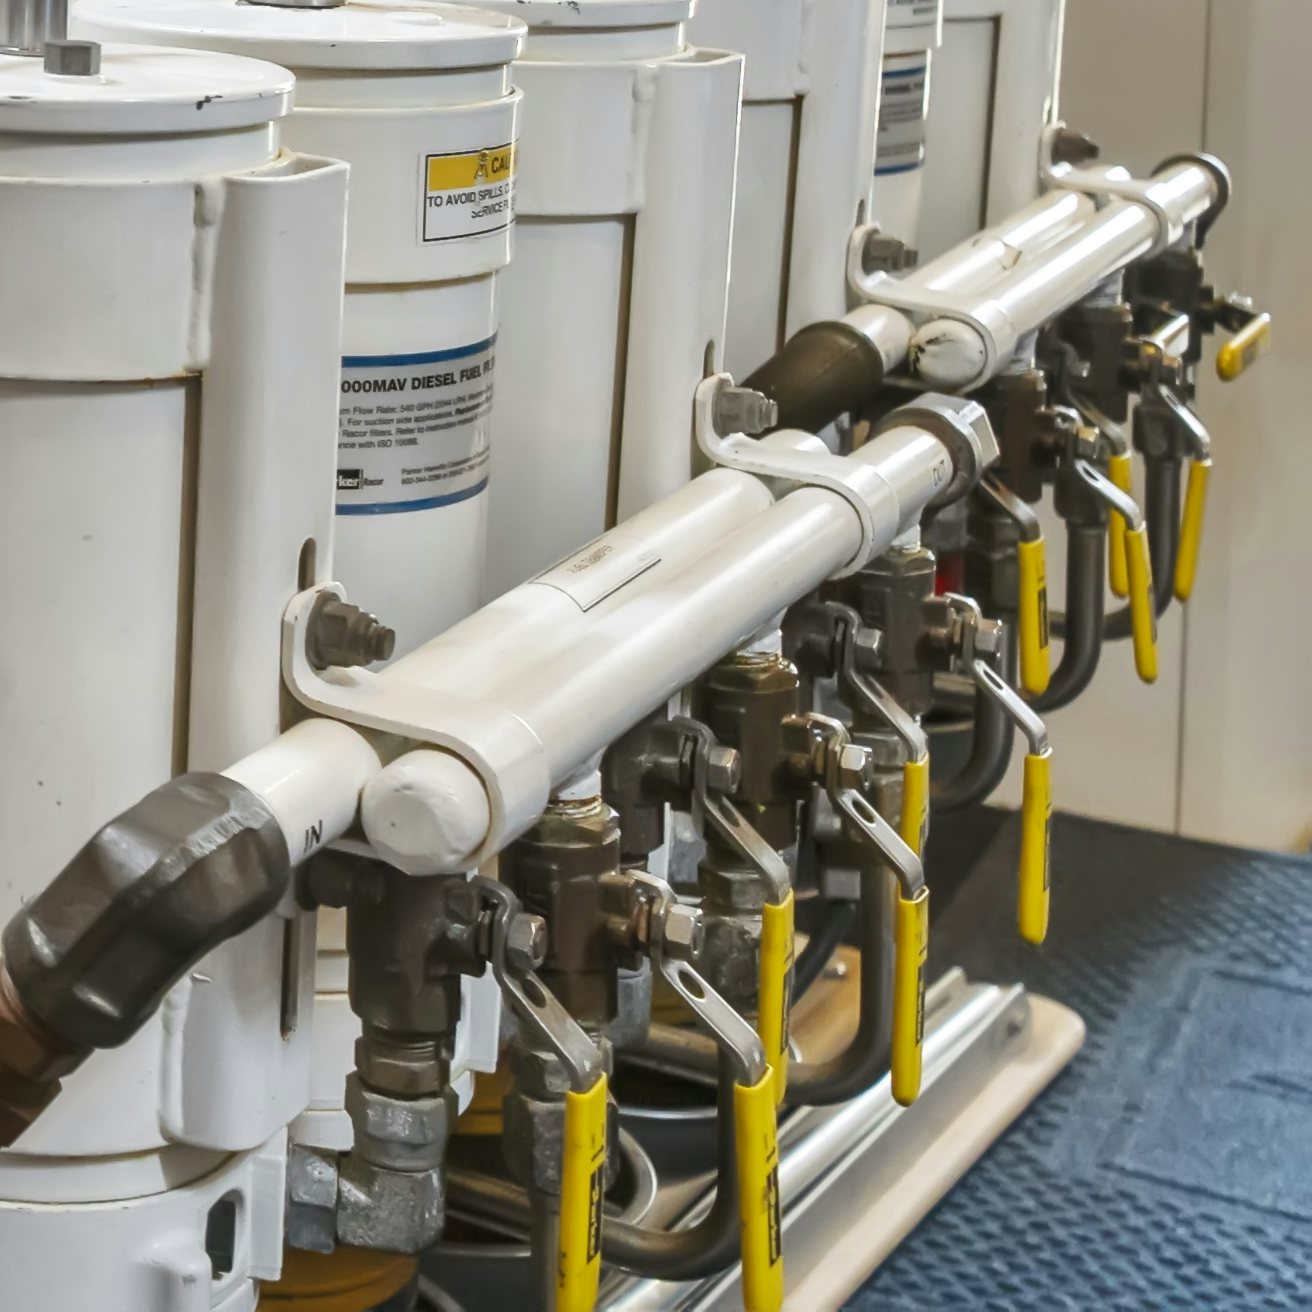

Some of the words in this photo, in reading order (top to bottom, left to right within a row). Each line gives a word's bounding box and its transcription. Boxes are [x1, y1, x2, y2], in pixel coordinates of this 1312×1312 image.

[427, 196, 443, 207] TO
[446, 192, 476, 206] AVOID
[411, 373, 457, 390] DIESEL
[460, 367, 481, 383] FUEL
[365, 417, 394, 425] suction
[396, 415, 412, 423] side
[358, 440, 375, 448] with
[377, 439, 392, 447] ISO
[304, 819, 323, 856] IN
